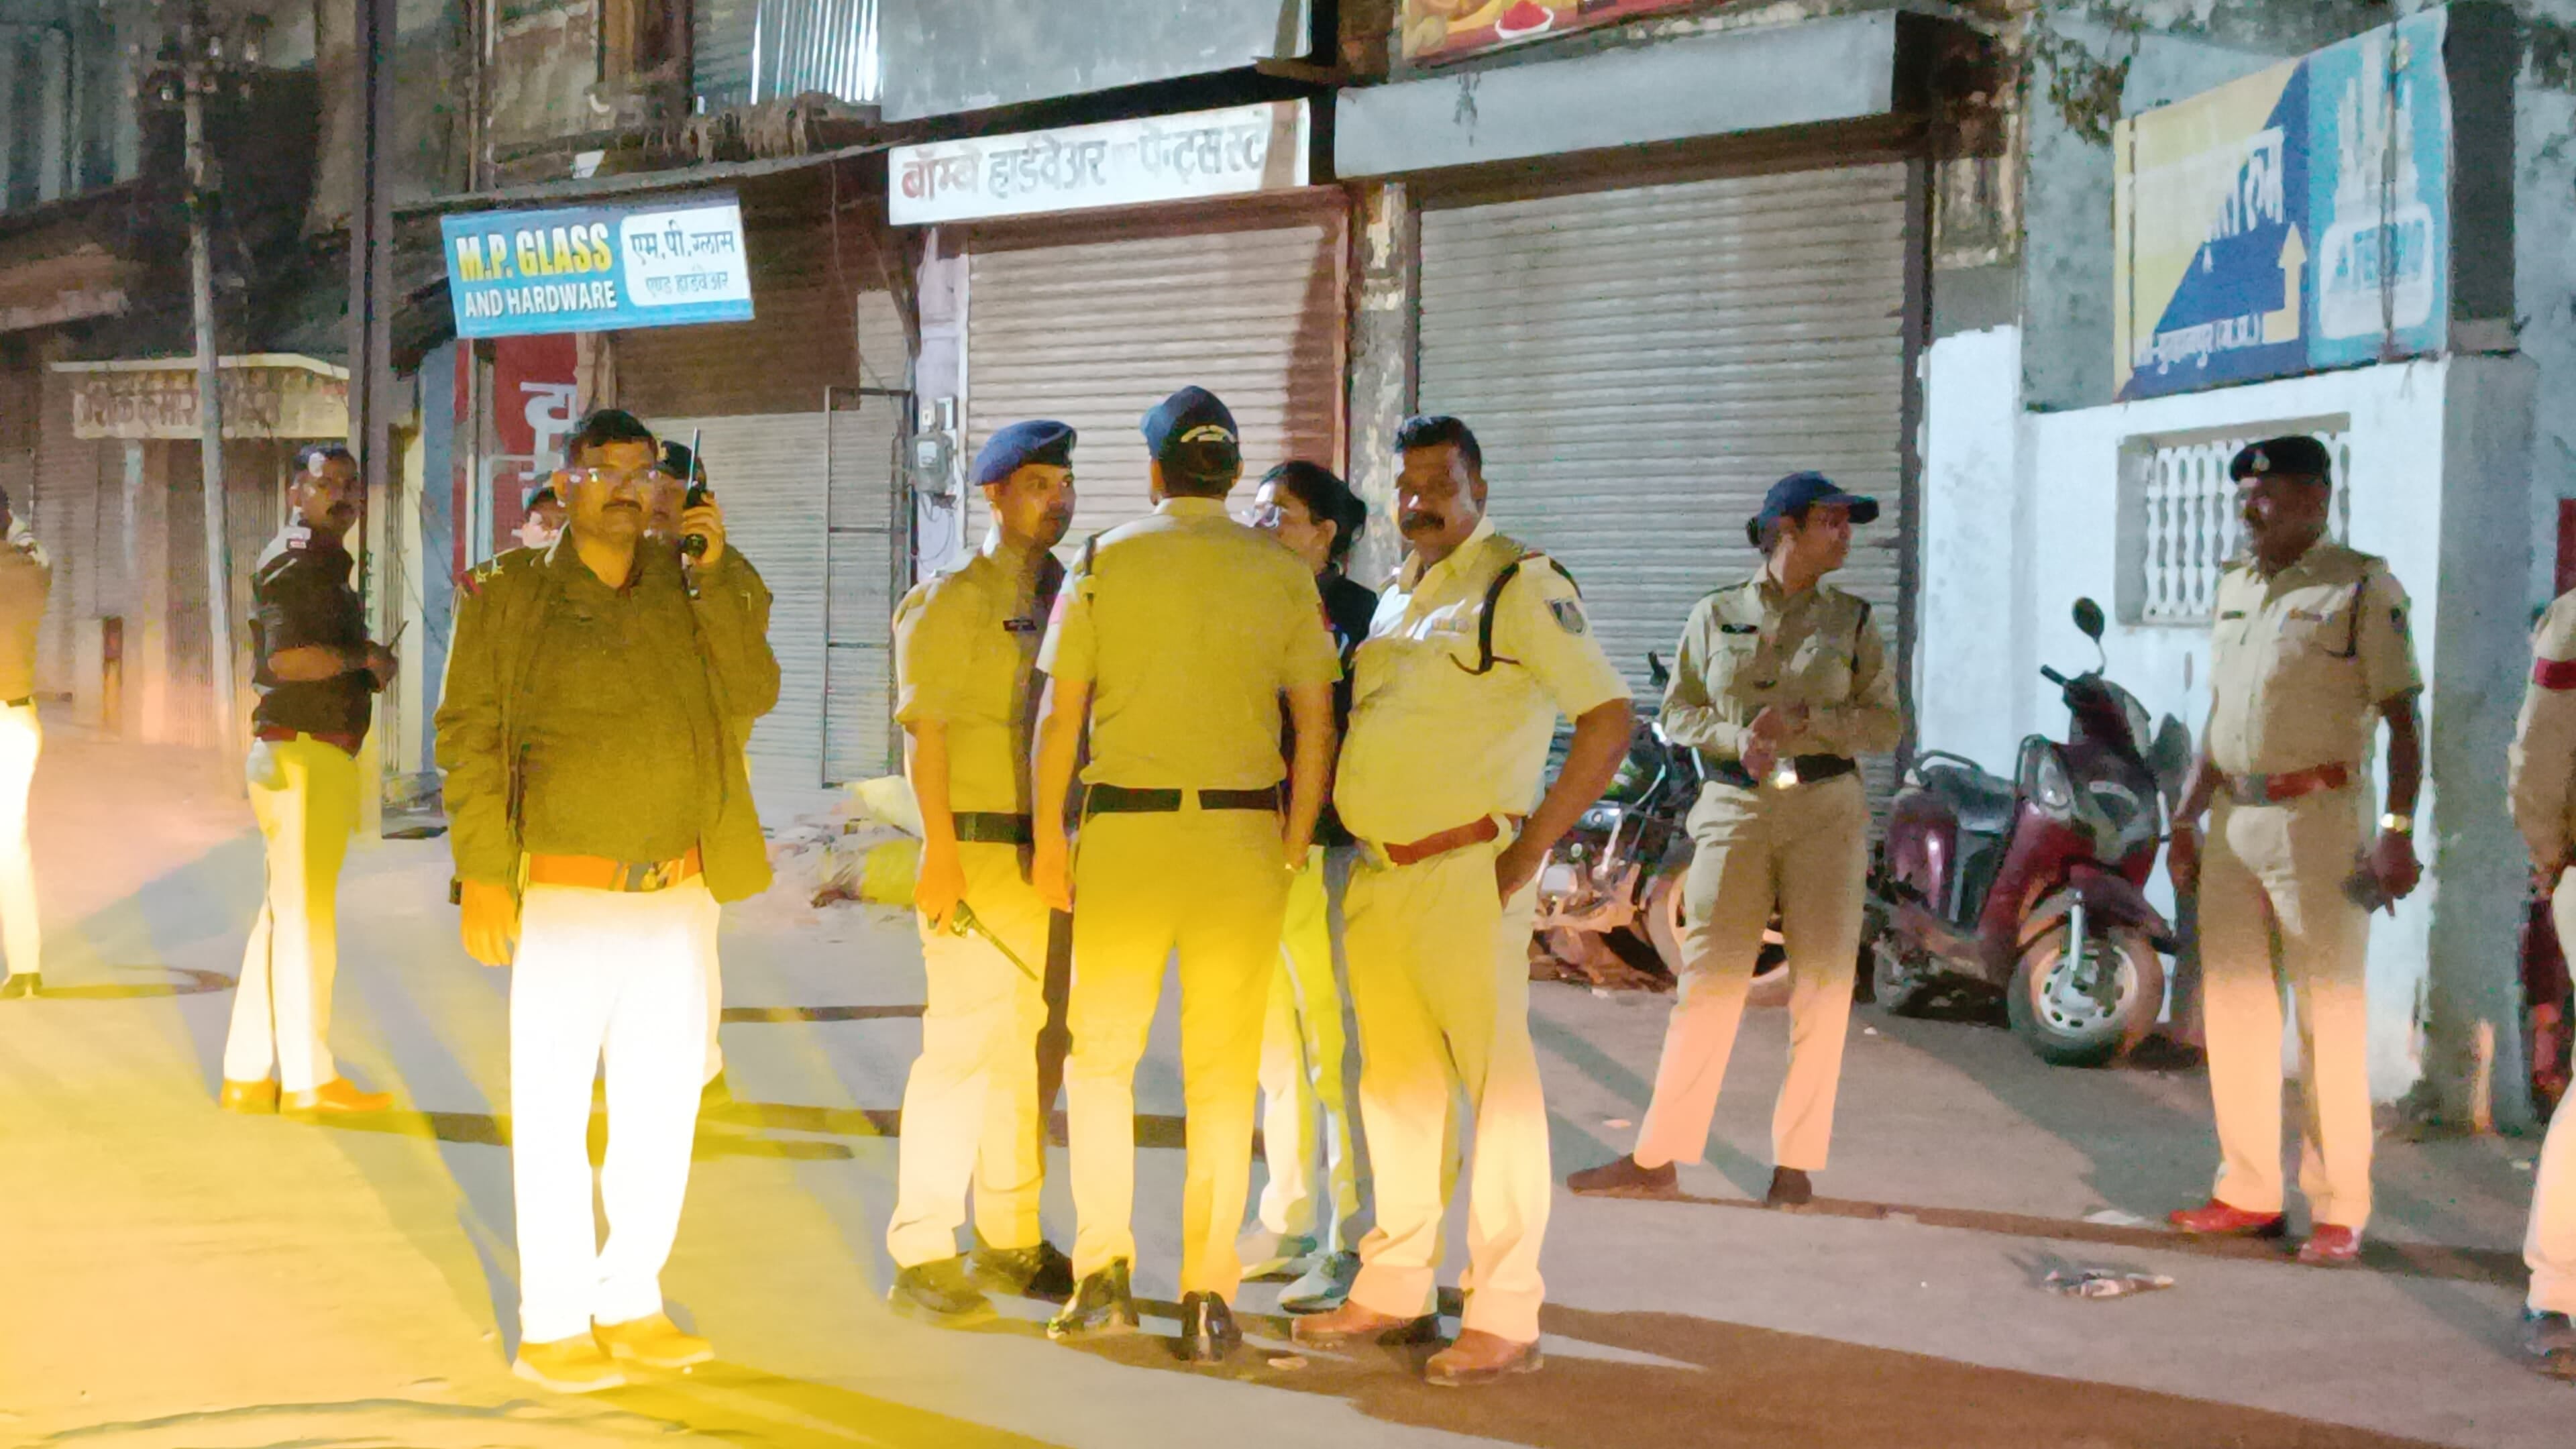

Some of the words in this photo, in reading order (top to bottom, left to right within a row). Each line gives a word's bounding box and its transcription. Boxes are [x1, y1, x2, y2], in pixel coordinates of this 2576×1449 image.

[456, 233, 513, 282] M.P.
[515, 223, 612, 276] GLASS
[465, 288, 504, 317] AND
[508, 280, 618, 314] HARDWARE
